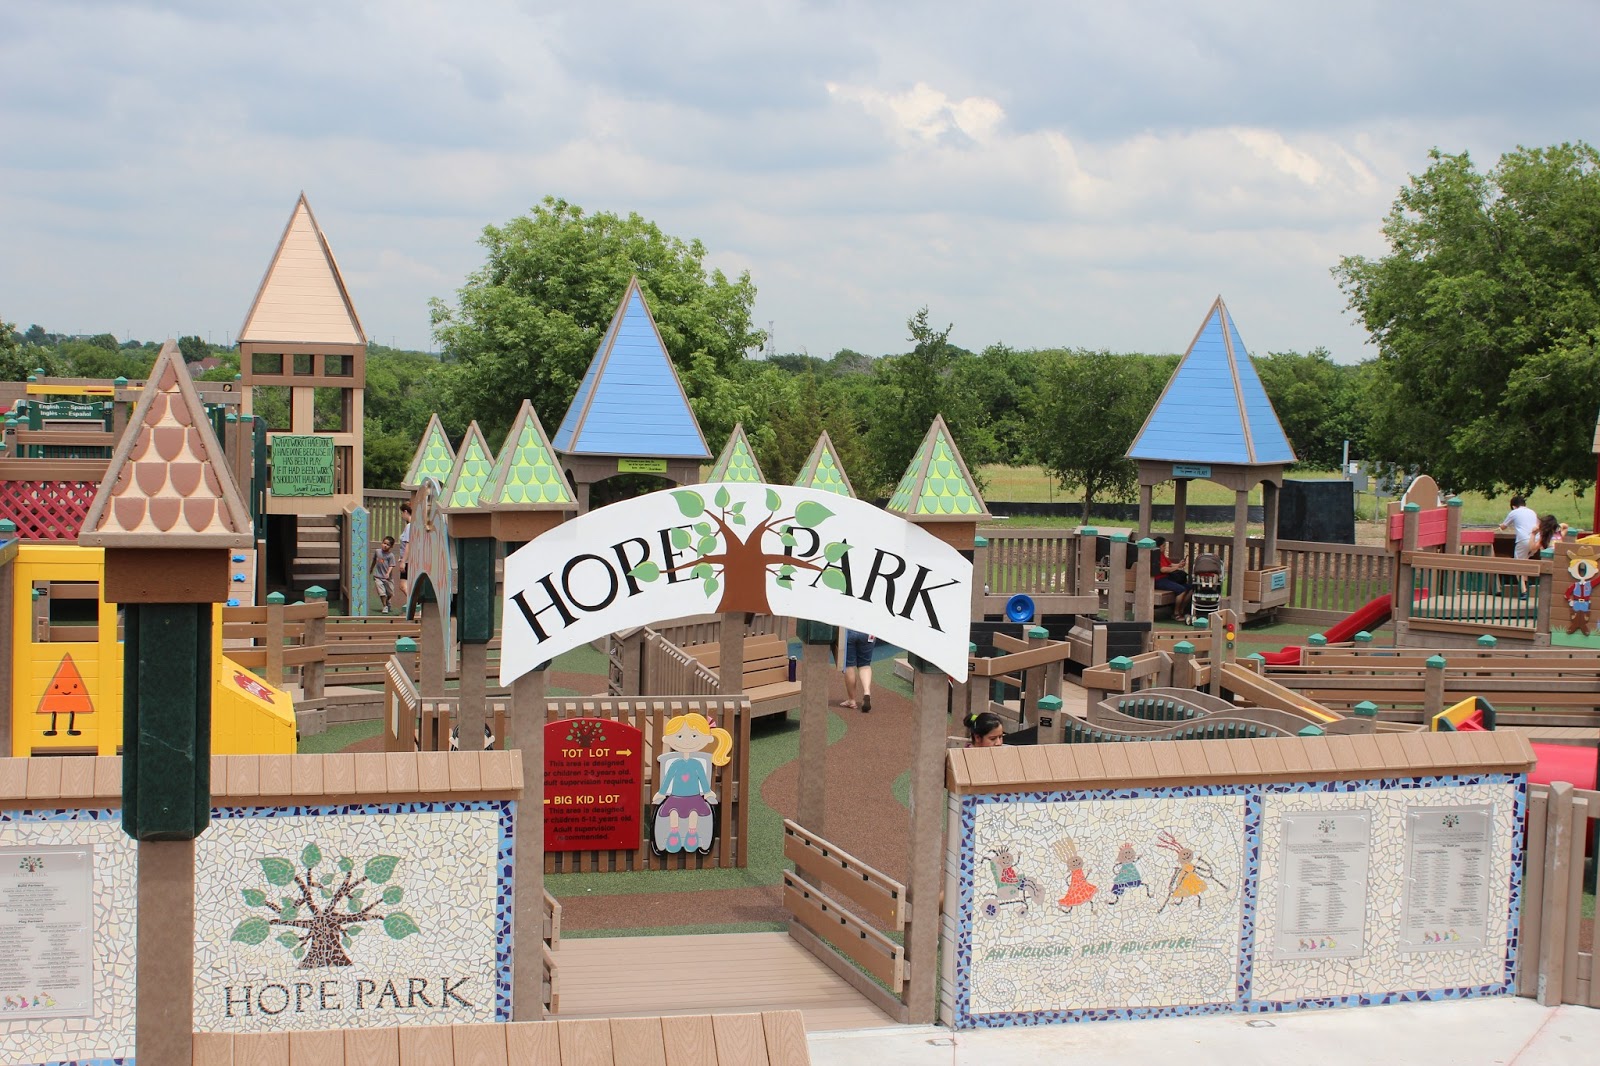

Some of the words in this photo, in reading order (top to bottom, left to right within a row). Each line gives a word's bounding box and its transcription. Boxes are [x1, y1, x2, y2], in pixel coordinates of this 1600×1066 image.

[509, 524, 700, 645] HOPE
[777, 525, 962, 634] PARK
[562, 749, 584, 758] TOT
[589, 749, 610, 758] LOT
[592, 760, 625, 768] designed
[560, 779, 601, 787] supervision
[554, 796, 572, 805] BIG
[576, 795, 594, 804] KID
[598, 795, 620, 804] LOT
[592, 806, 625, 814] designed
[551, 816, 580, 824] children
[598, 816, 618, 824] years
[574, 825, 616, 833] supervision
[985, 949, 1005, 961] AN
[1009, 946, 1072, 959] INCLUSIVE
[1080, 941, 1113, 957] PLAY
[224, 980, 341, 1017] HOPE
[356, 976, 474, 1011] PARK
